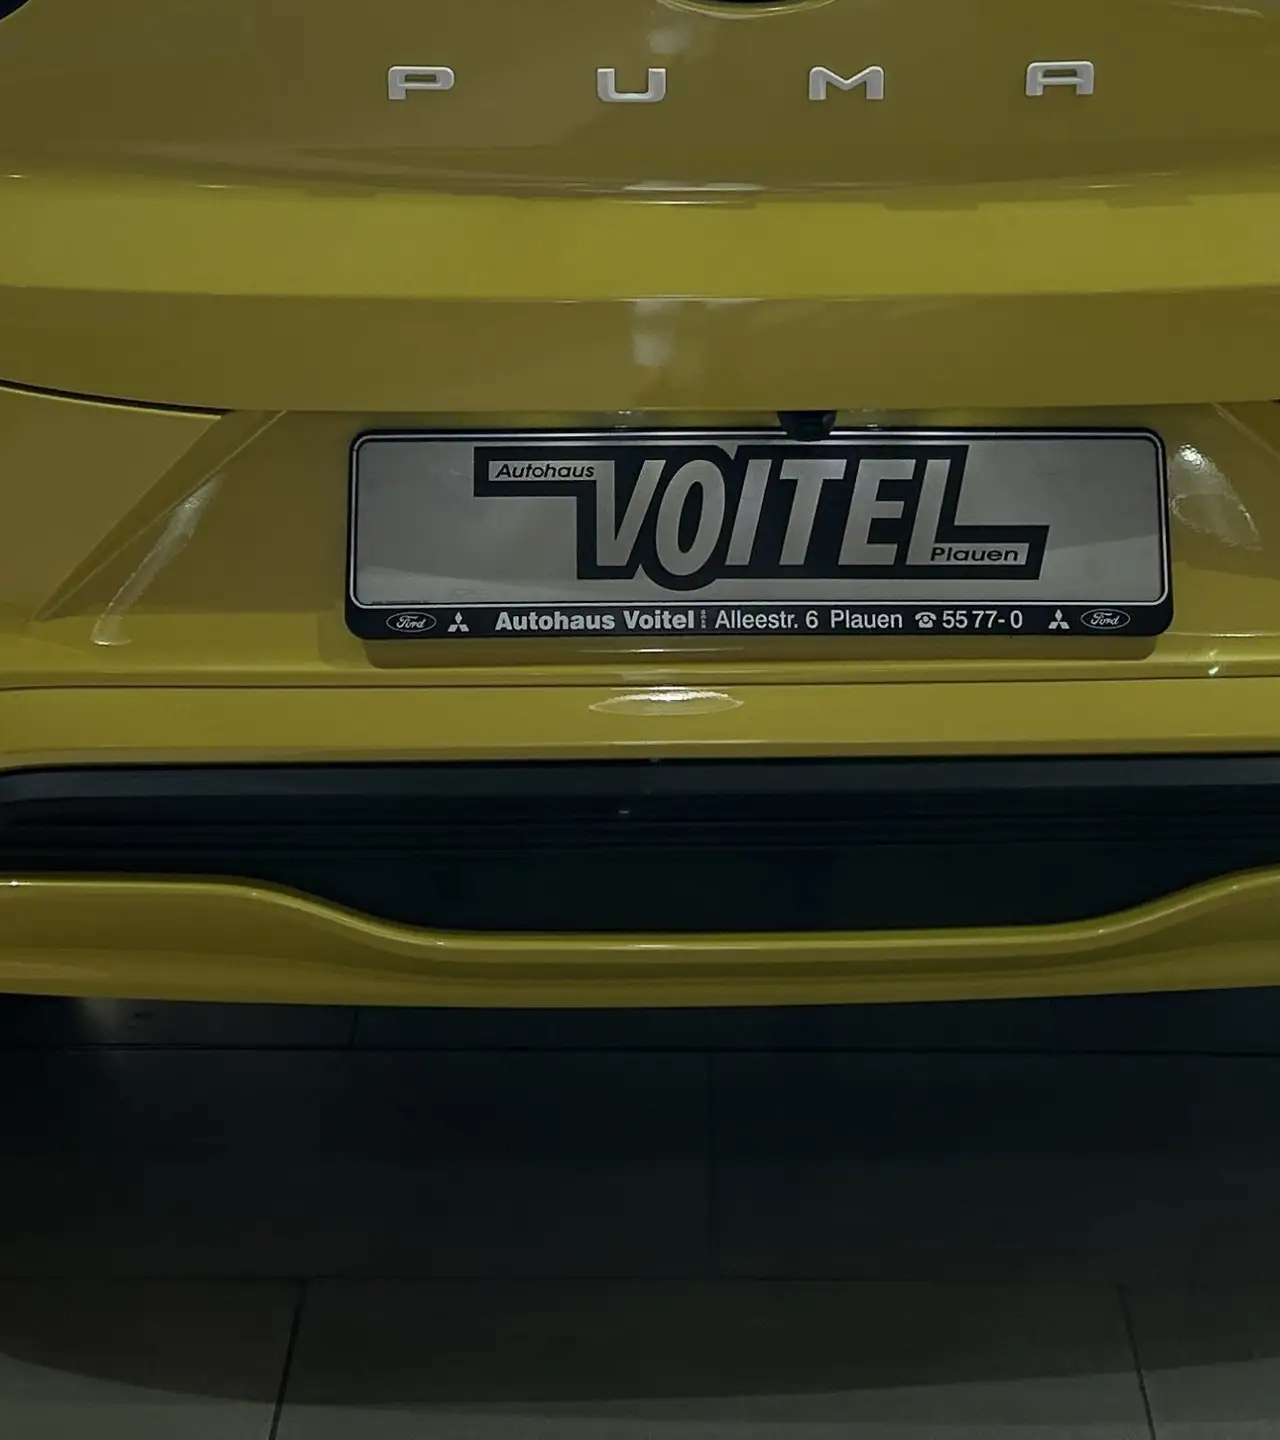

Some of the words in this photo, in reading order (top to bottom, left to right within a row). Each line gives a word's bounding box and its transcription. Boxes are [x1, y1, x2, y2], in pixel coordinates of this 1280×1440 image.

[387, 61, 1096, 104] PUMA
[495, 462, 596, 479] Autohaus
[590, 456, 960, 580] VOITEL
[929, 545, 1020, 563] Plauen
[494, 610, 616, 631] Autohaus
[622, 609, 695, 630] Voitel
[714, 609, 799, 629] Alleestr.
[804, 610, 820, 629] 6
[830, 609, 903, 629] Plauen
